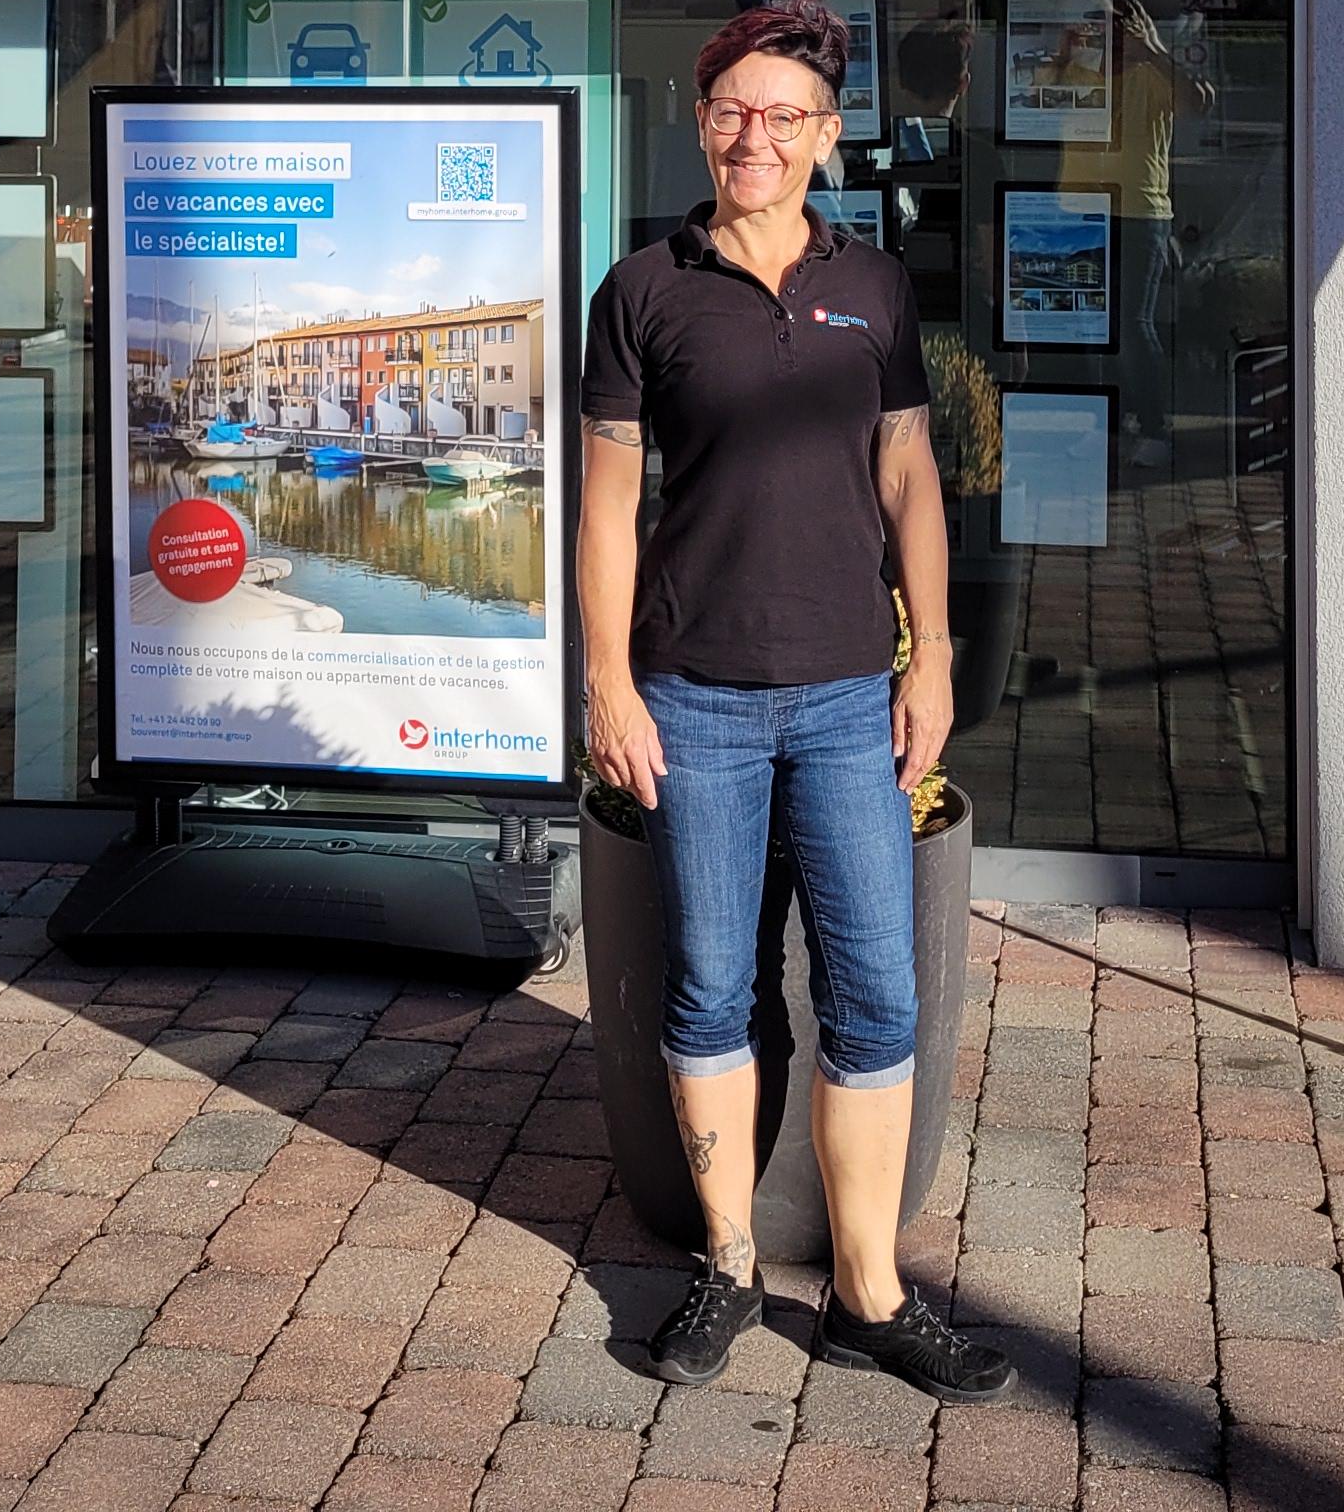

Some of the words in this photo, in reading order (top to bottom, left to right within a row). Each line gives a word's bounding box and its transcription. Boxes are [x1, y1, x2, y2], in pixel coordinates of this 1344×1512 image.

[133, 152, 196, 171] Louez
[203, 154, 257, 171] votre
[266, 152, 345, 172] maison
[134, 190, 159, 211] de
[165, 194, 268, 213] vacances
[274, 195, 325, 212] avec
[417, 207, 518, 217] myhome.interhome.group
[135, 231, 153, 250] le
[158, 230, 285, 254] spécialiste!
[162, 527, 229, 546] Consultation
[158, 546, 199, 564] gratuite
[200, 544, 212, 556] et
[213, 541, 239, 554] sans
[169, 556, 233, 576] engagement
[130, 642, 164, 656] Nous
[168, 646, 200, 658] nous
[203, 647, 268, 664] occupons
[271, 648, 288, 661] de
[291, 649, 304, 662] la
[308, 649, 434, 667] commercialisation
[439, 655, 452, 667] et
[456, 654, 474, 668] de
[476, 655, 490, 669] la
[493, 656, 545, 673] gestion
[130, 662, 192, 680] complète
[196, 663, 213, 677] de
[216, 666, 250, 679] votre
[253, 667, 303, 681] maison
[307, 670, 323, 681] ou
[326, 670, 415, 688] appartement
[419, 673, 436, 687] de
[440, 676, 509, 690] vacances.
[167, 715, 178, 724] 24
[433, 726, 548, 752] interhome
[434, 751, 468, 759] GROUP
